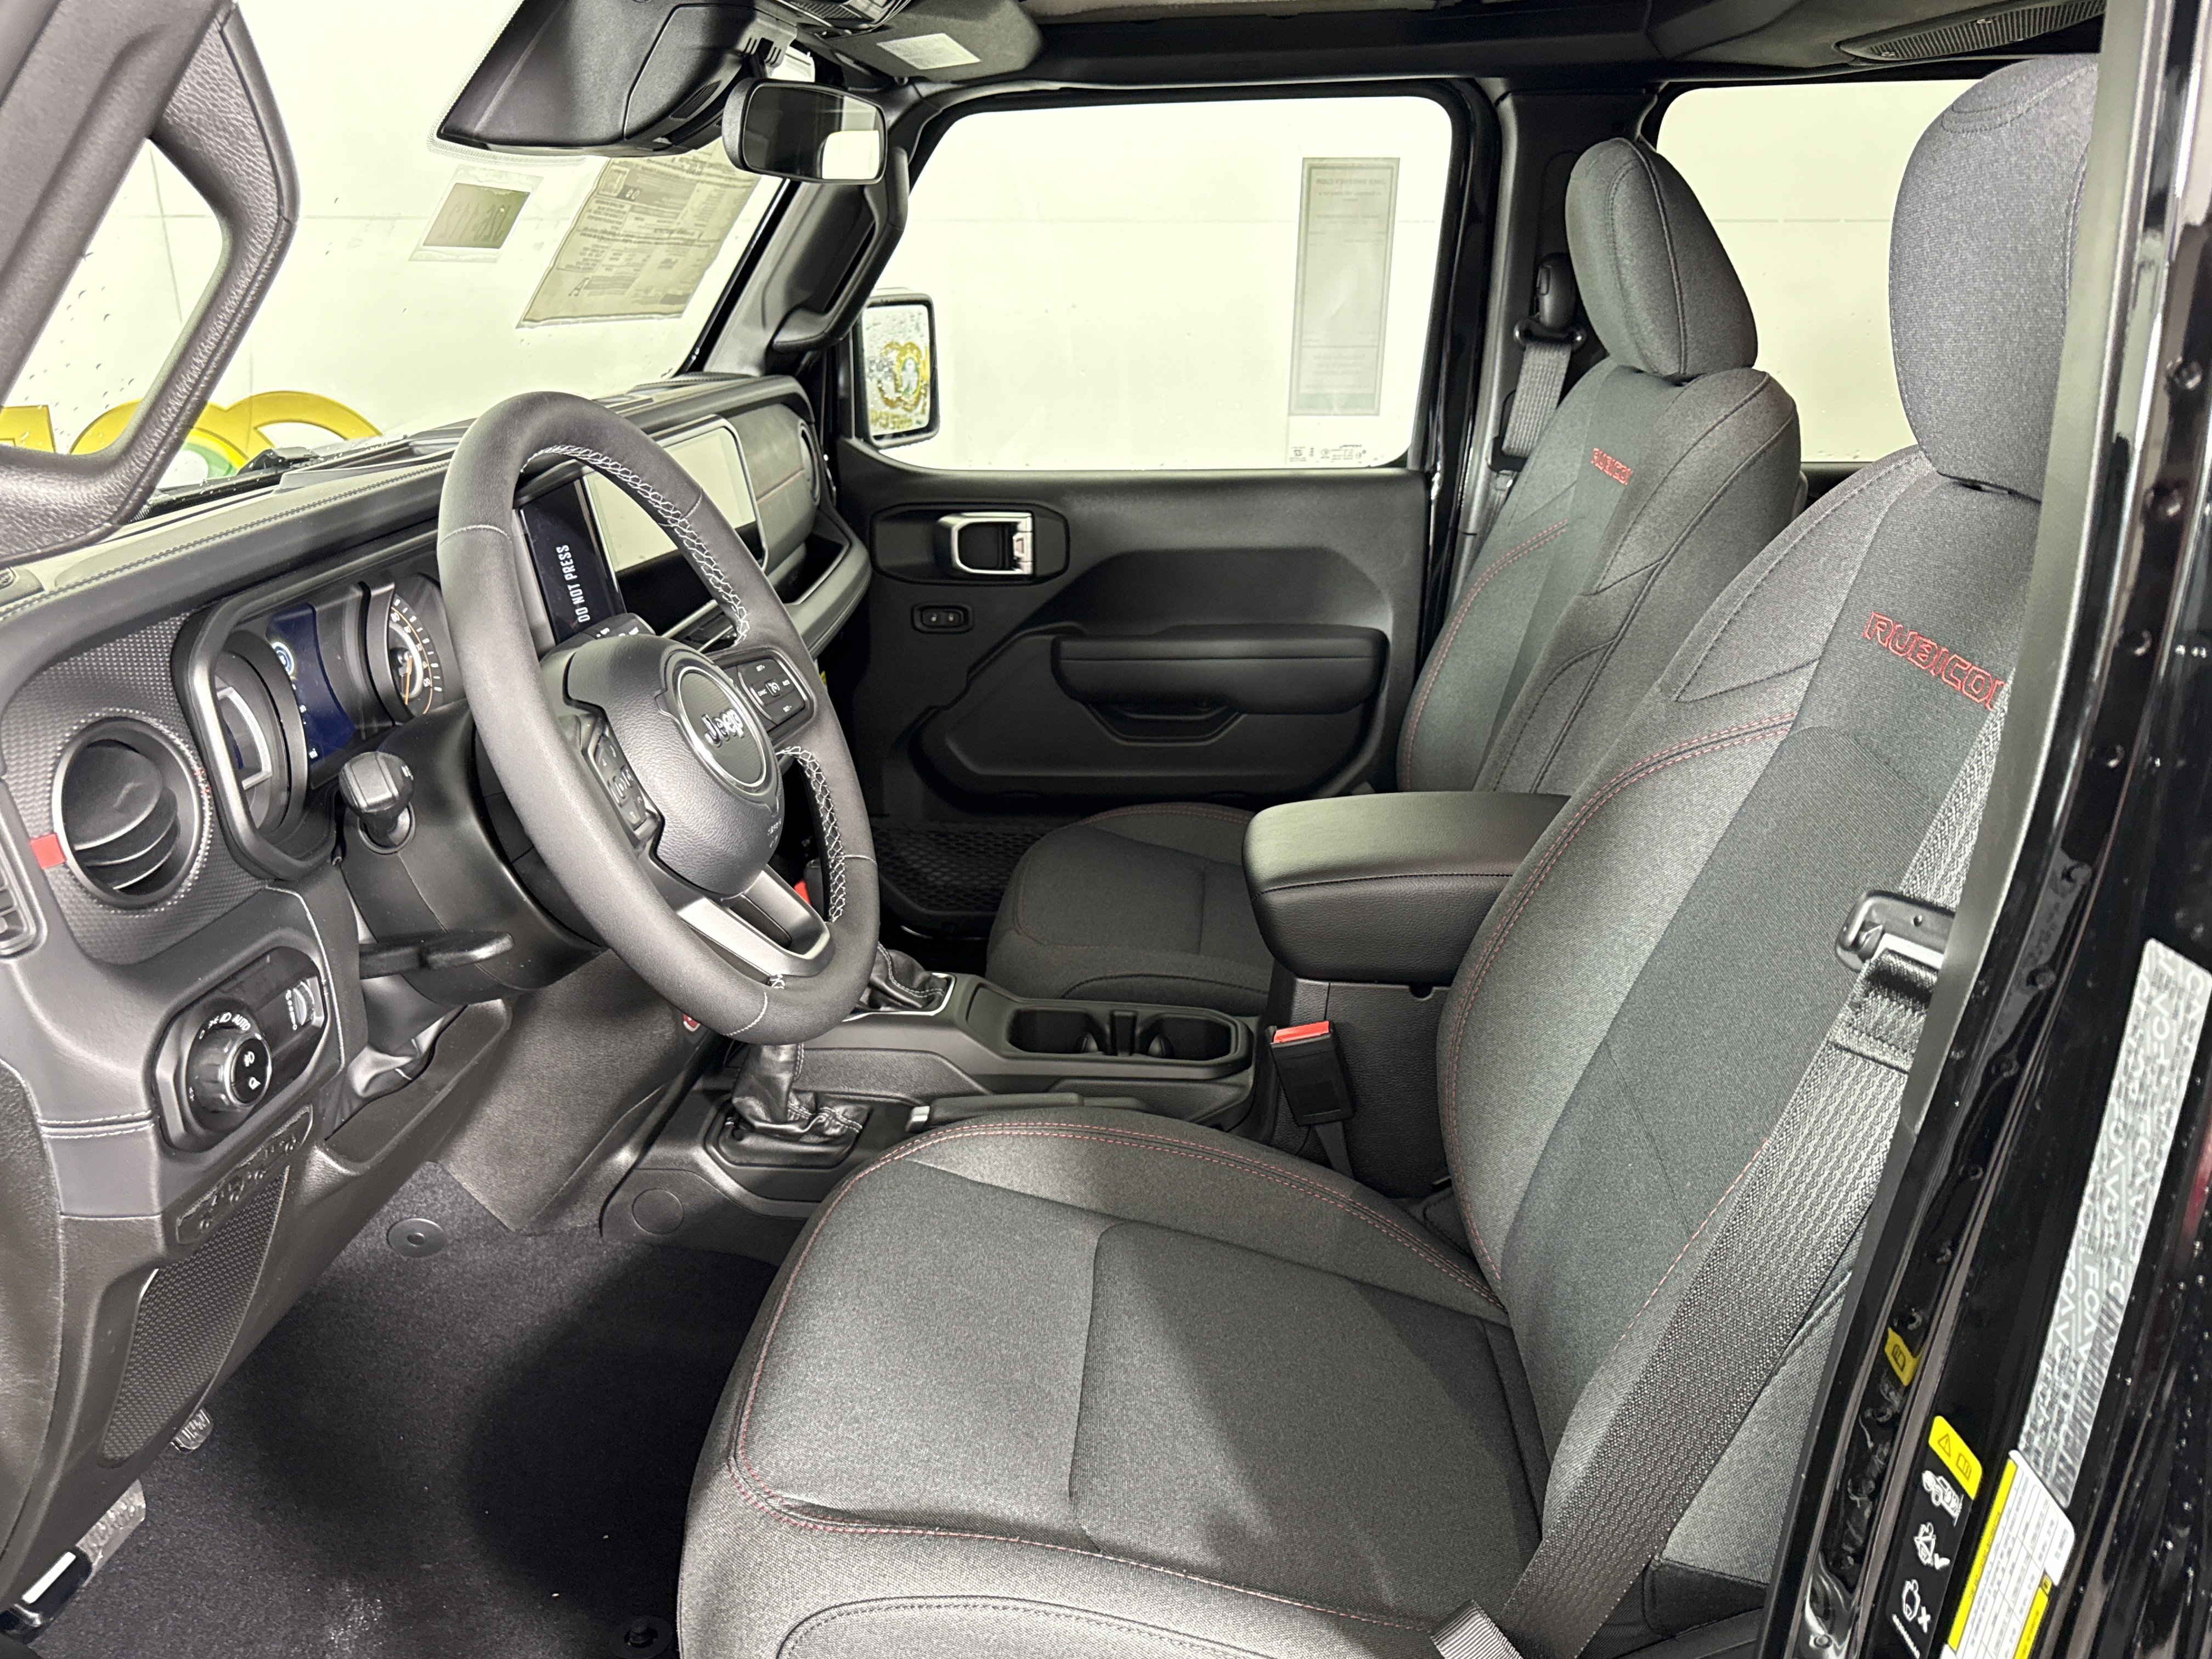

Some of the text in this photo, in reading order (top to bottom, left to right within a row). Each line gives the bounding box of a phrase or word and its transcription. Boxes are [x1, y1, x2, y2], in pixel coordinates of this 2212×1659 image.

[555, 544, 590, 623] DO NOT PRESS
[704, 708, 745, 747] Jeep
[232, 1014, 251, 1031] AUTO
